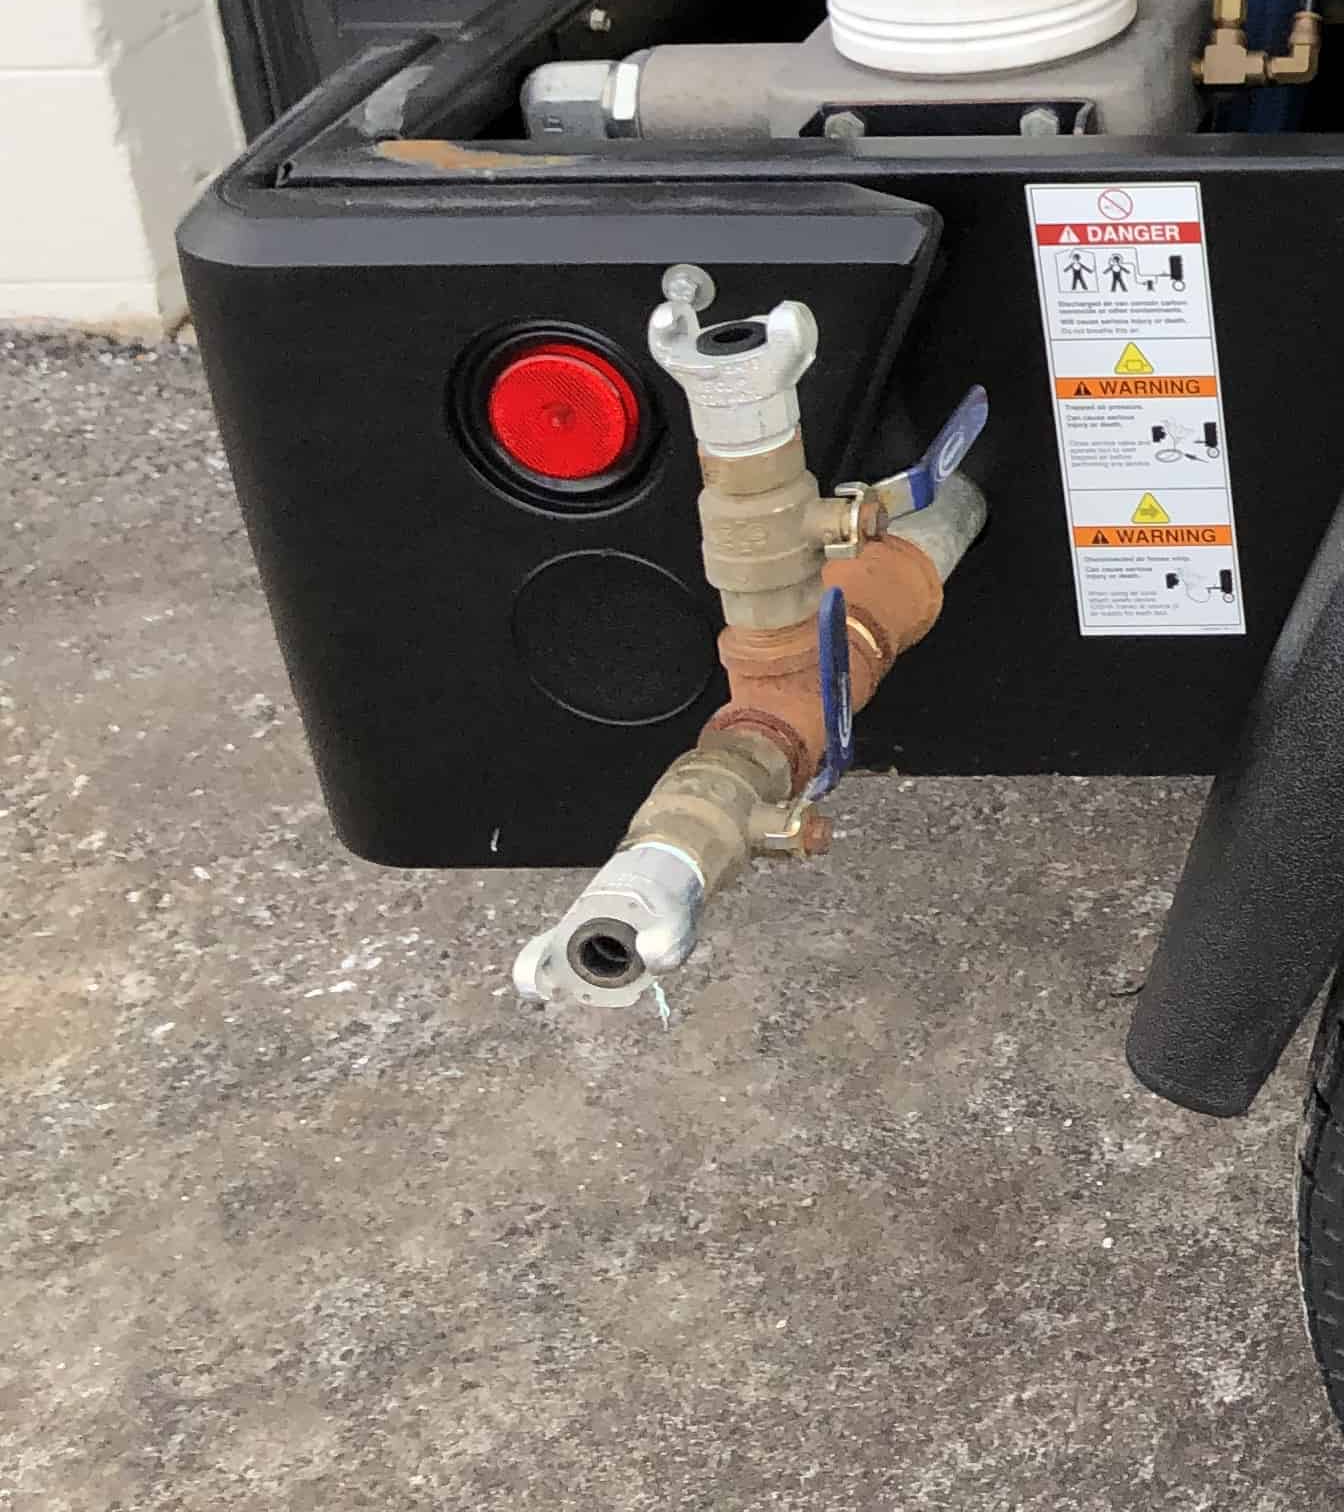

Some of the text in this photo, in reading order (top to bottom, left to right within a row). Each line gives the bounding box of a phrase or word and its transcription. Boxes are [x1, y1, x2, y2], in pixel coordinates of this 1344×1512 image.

[1088, 225, 1180, 242] DANGER
[1100, 380, 1200, 394] WARNING
[1116, 529, 1216, 544] WARNING
